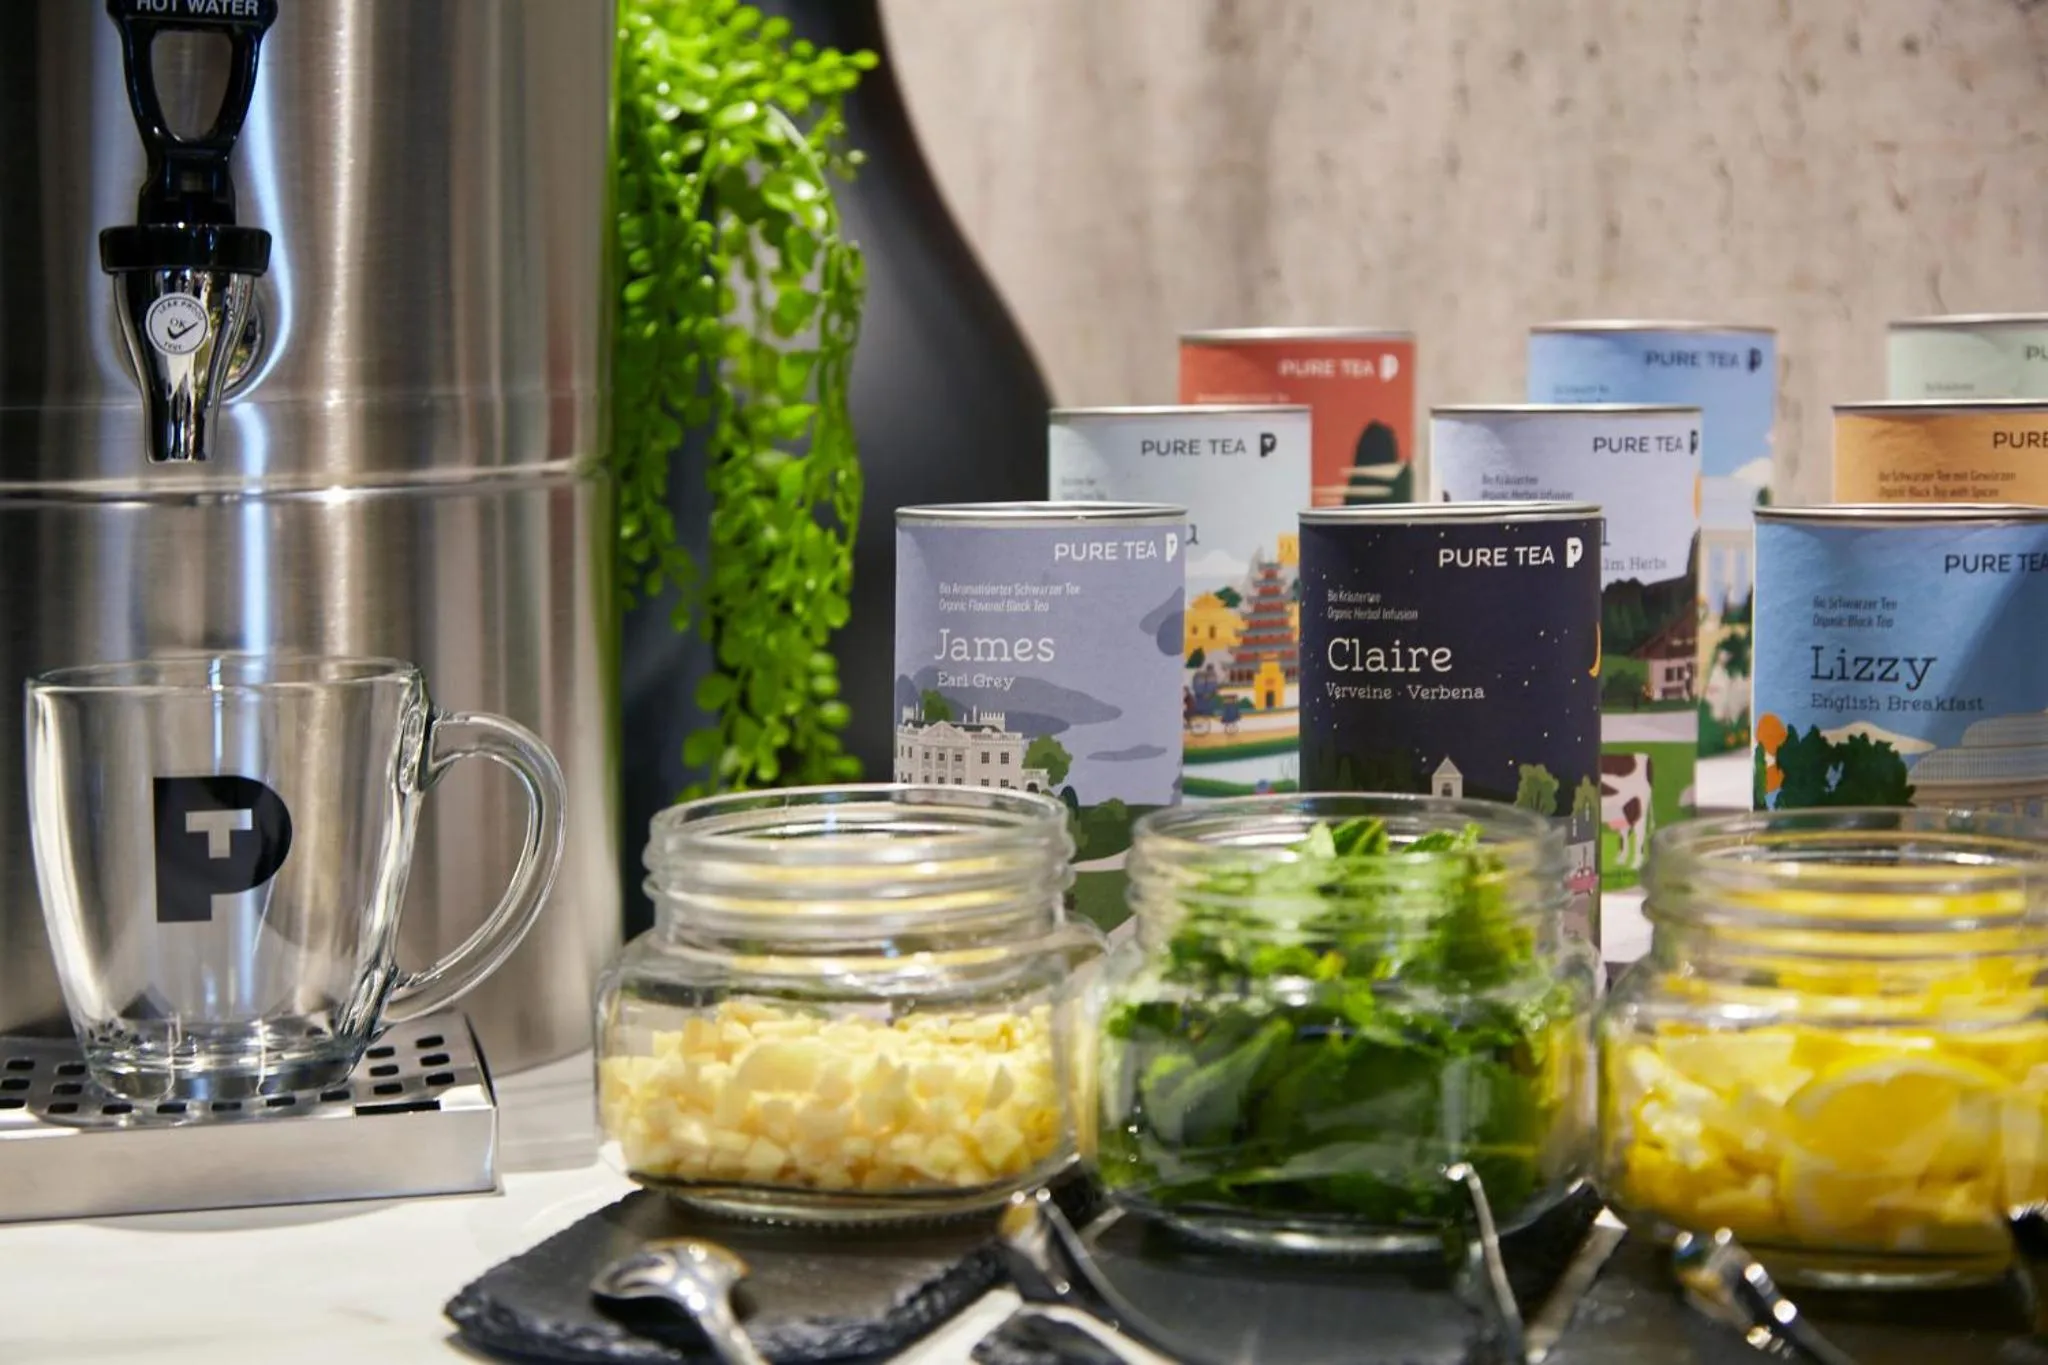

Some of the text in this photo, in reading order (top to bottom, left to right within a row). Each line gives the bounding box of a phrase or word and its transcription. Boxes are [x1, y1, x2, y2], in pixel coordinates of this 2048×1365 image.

[136, 0, 259, 15] HOT WATER
[1278, 358, 1336, 378] PURE
[1340, 358, 1375, 379] TEA
[1645, 351, 1698, 368] PURE
[1706, 351, 1740, 368] TEA
[1141, 438, 1200, 456] PURE
[1208, 438, 1247, 455] TEA
[1593, 436, 1649, 453] PURE
[1656, 436, 1683, 453] TEA
[1054, 542, 1118, 561] PURE
[1123, 540, 1158, 560] TEA
[1439, 548, 1508, 567] PURE
[1514, 546, 1555, 566] TEA
[1945, 553, 2013, 574] PURE
[934, 628, 1055, 663] James
[1327, 637, 1453, 673] Claire
[1810, 645, 1938, 692] Lizzy
[937, 671, 1015, 691] Earl Grey
[1326, 682, 1485, 700] Verveine Verbena
[1811, 693, 1985, 713] English Breakfast
